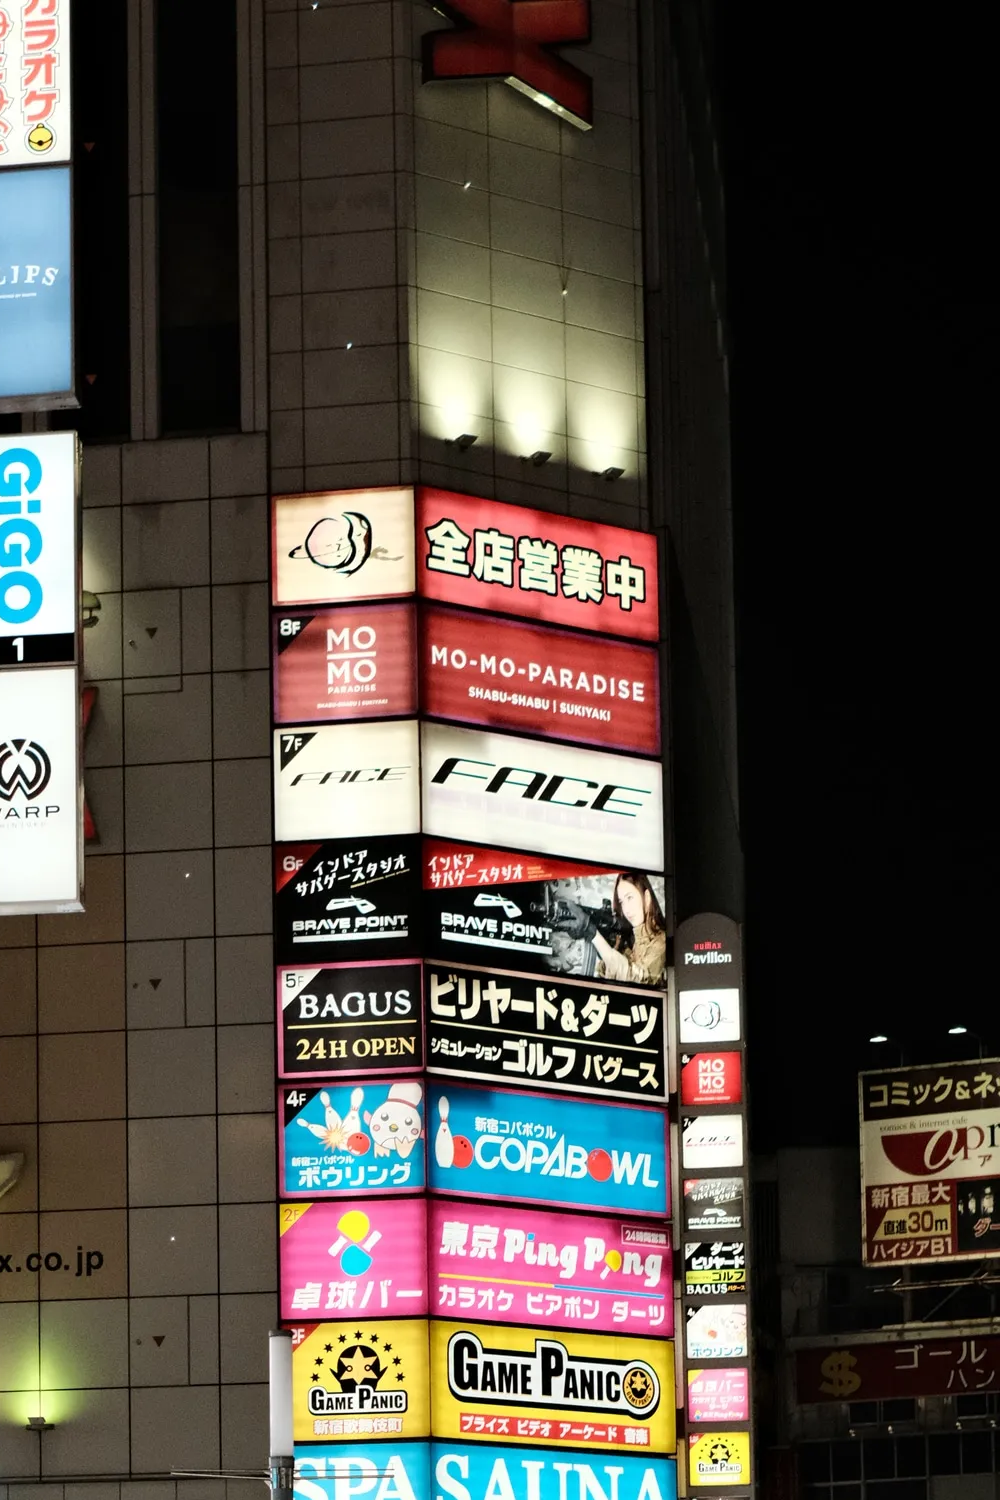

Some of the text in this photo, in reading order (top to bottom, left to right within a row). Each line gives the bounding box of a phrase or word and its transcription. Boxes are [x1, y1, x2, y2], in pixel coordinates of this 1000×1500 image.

[424, 517, 647, 611] 全店営業中
[280, 618, 301, 636] 8F
[327, 626, 377, 652] MO
[12, 637, 25, 662] 1
[327, 659, 377, 685] MO
[431, 644, 645, 702] MO-MO-PARADISE
[327, 684, 377, 695] PARADISE
[468, 686, 611, 722] SHABU-SHABU SUKIYAKI
[282, 735, 303, 753] 7F
[290, 766, 412, 787] FACE
[430, 757, 652, 818] FACE
[283, 855, 304, 872] 6F
[313, 849, 368, 876] インドア
[428, 853, 475, 872] インドア
[295, 853, 407, 897] サバゲースタジオ
[430, 863, 524, 888] サバゲースタジオ
[292, 914, 409, 932] BRAVE POINT
[440, 911, 553, 941] BRAVE POINT
[684, 951, 732, 965] Pavilion
[285, 972, 304, 989] 5F
[299, 990, 412, 1019] BAGUS
[429, 972, 659, 1045] ビリヤード&ダーツ
[296, 1036, 416, 1060] 24H OPEN
[583, 1054, 660, 1089] バグース
[698, 1059, 725, 1073] MO
[698, 1076, 725, 1090] MO
[286, 1091, 307, 1106] 4F
[475, 1116, 557, 1140] 新宿コパボウル
[474, 1133, 660, 1188] COPABOWL
[298, 1161, 412, 1188] ボウリング
[871, 1181, 951, 1209] 新宿最大
[283, 1207, 300, 1224] 2F
[439, 1220, 500, 1260] 東京
[503, 1227, 579, 1279] Ping
[710, 1242, 744, 1256] ダーツ
[691, 1255, 745, 1271] ビリヤード
[711, 1270, 744, 1282] ゴルフ
[291, 1279, 423, 1311] 卓球バー
[686, 1283, 728, 1295] BAGUS
[438, 1283, 665, 1326] カラオケ ビアポン ダーツ
[691, 1346, 745, 1358] ボウリング
[453, 1337, 621, 1402] GAME PANIC
[311, 1388, 404, 1412] GAME PANIC
[313, 1417, 404, 1435] 新宿歌舞伎町
[461, 1414, 649, 1445] プライズ ビデオ アーケード 音楽
